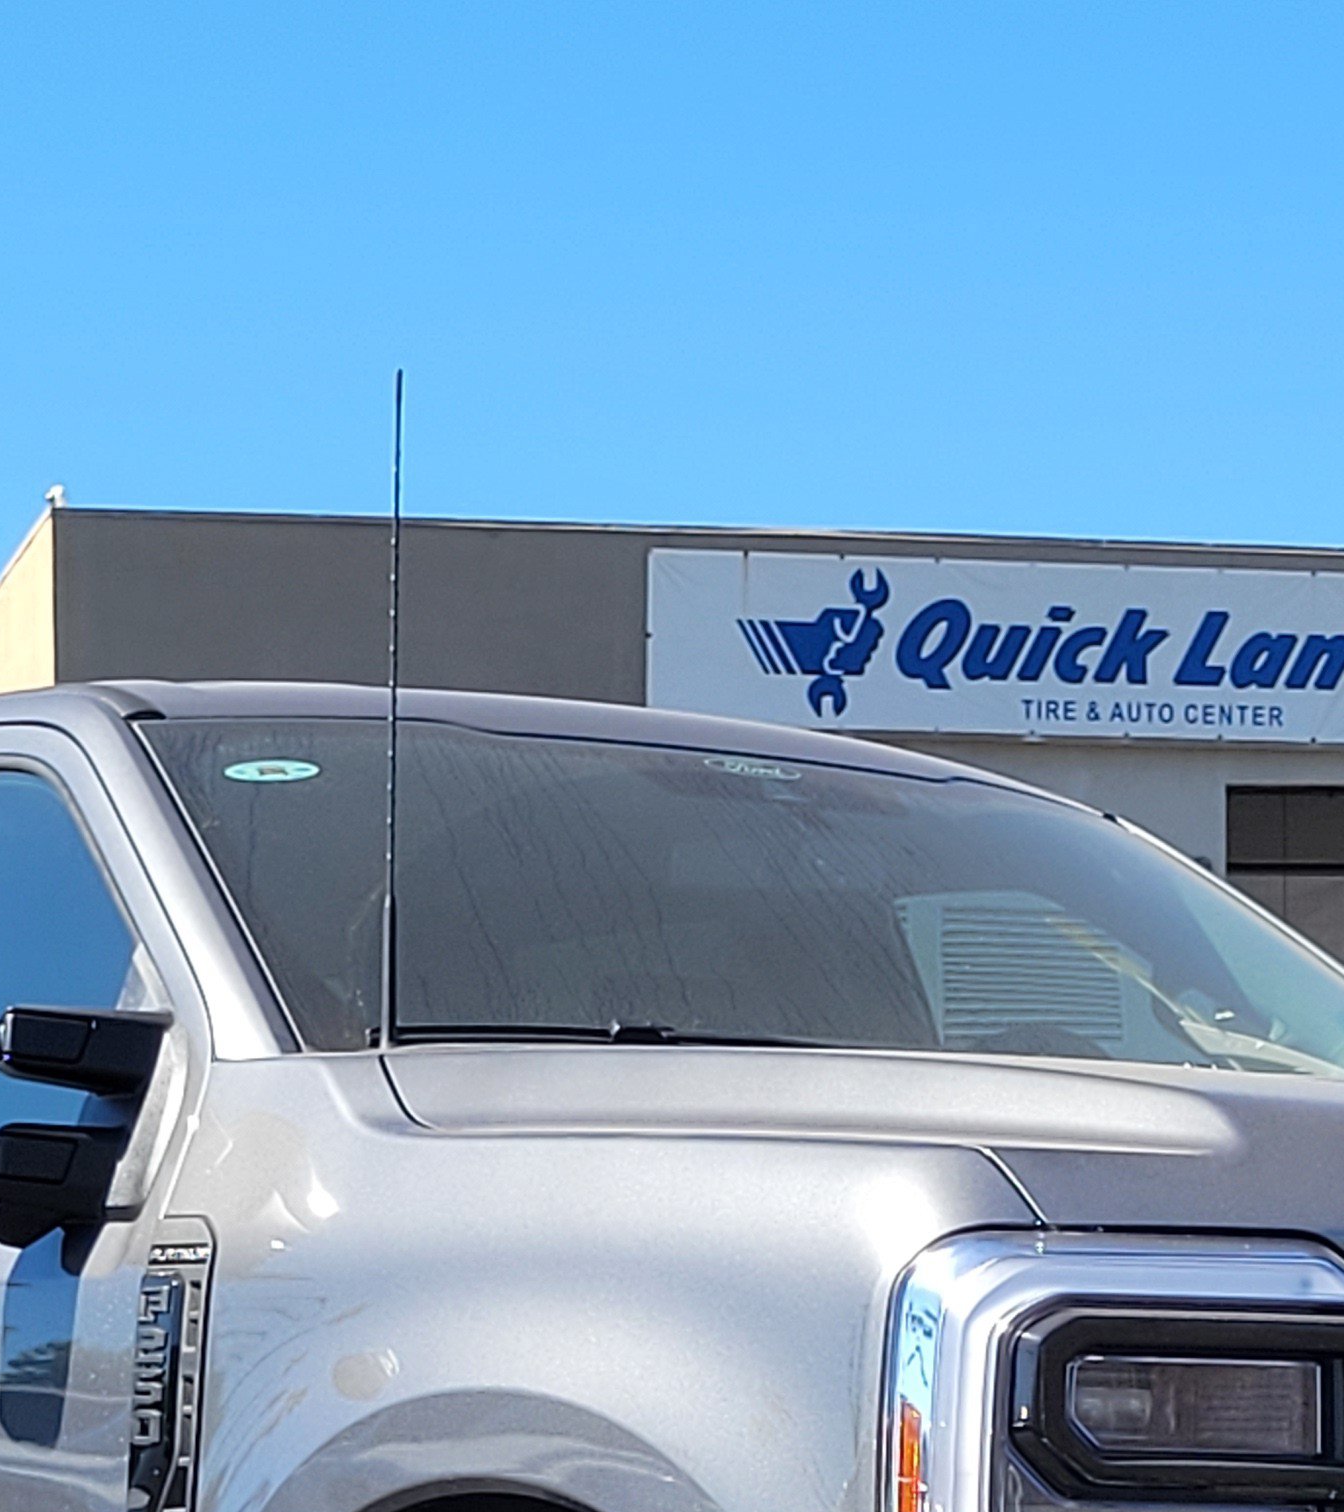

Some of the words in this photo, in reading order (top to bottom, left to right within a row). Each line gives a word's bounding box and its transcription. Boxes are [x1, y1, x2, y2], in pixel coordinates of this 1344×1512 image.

[895, 598, 1169, 692] Quick
[1021, 698, 1081, 722] TIRE
[1088, 700, 1102, 723] &
[1109, 701, 1176, 725] AUTO
[1184, 703, 1285, 728] CENTER
